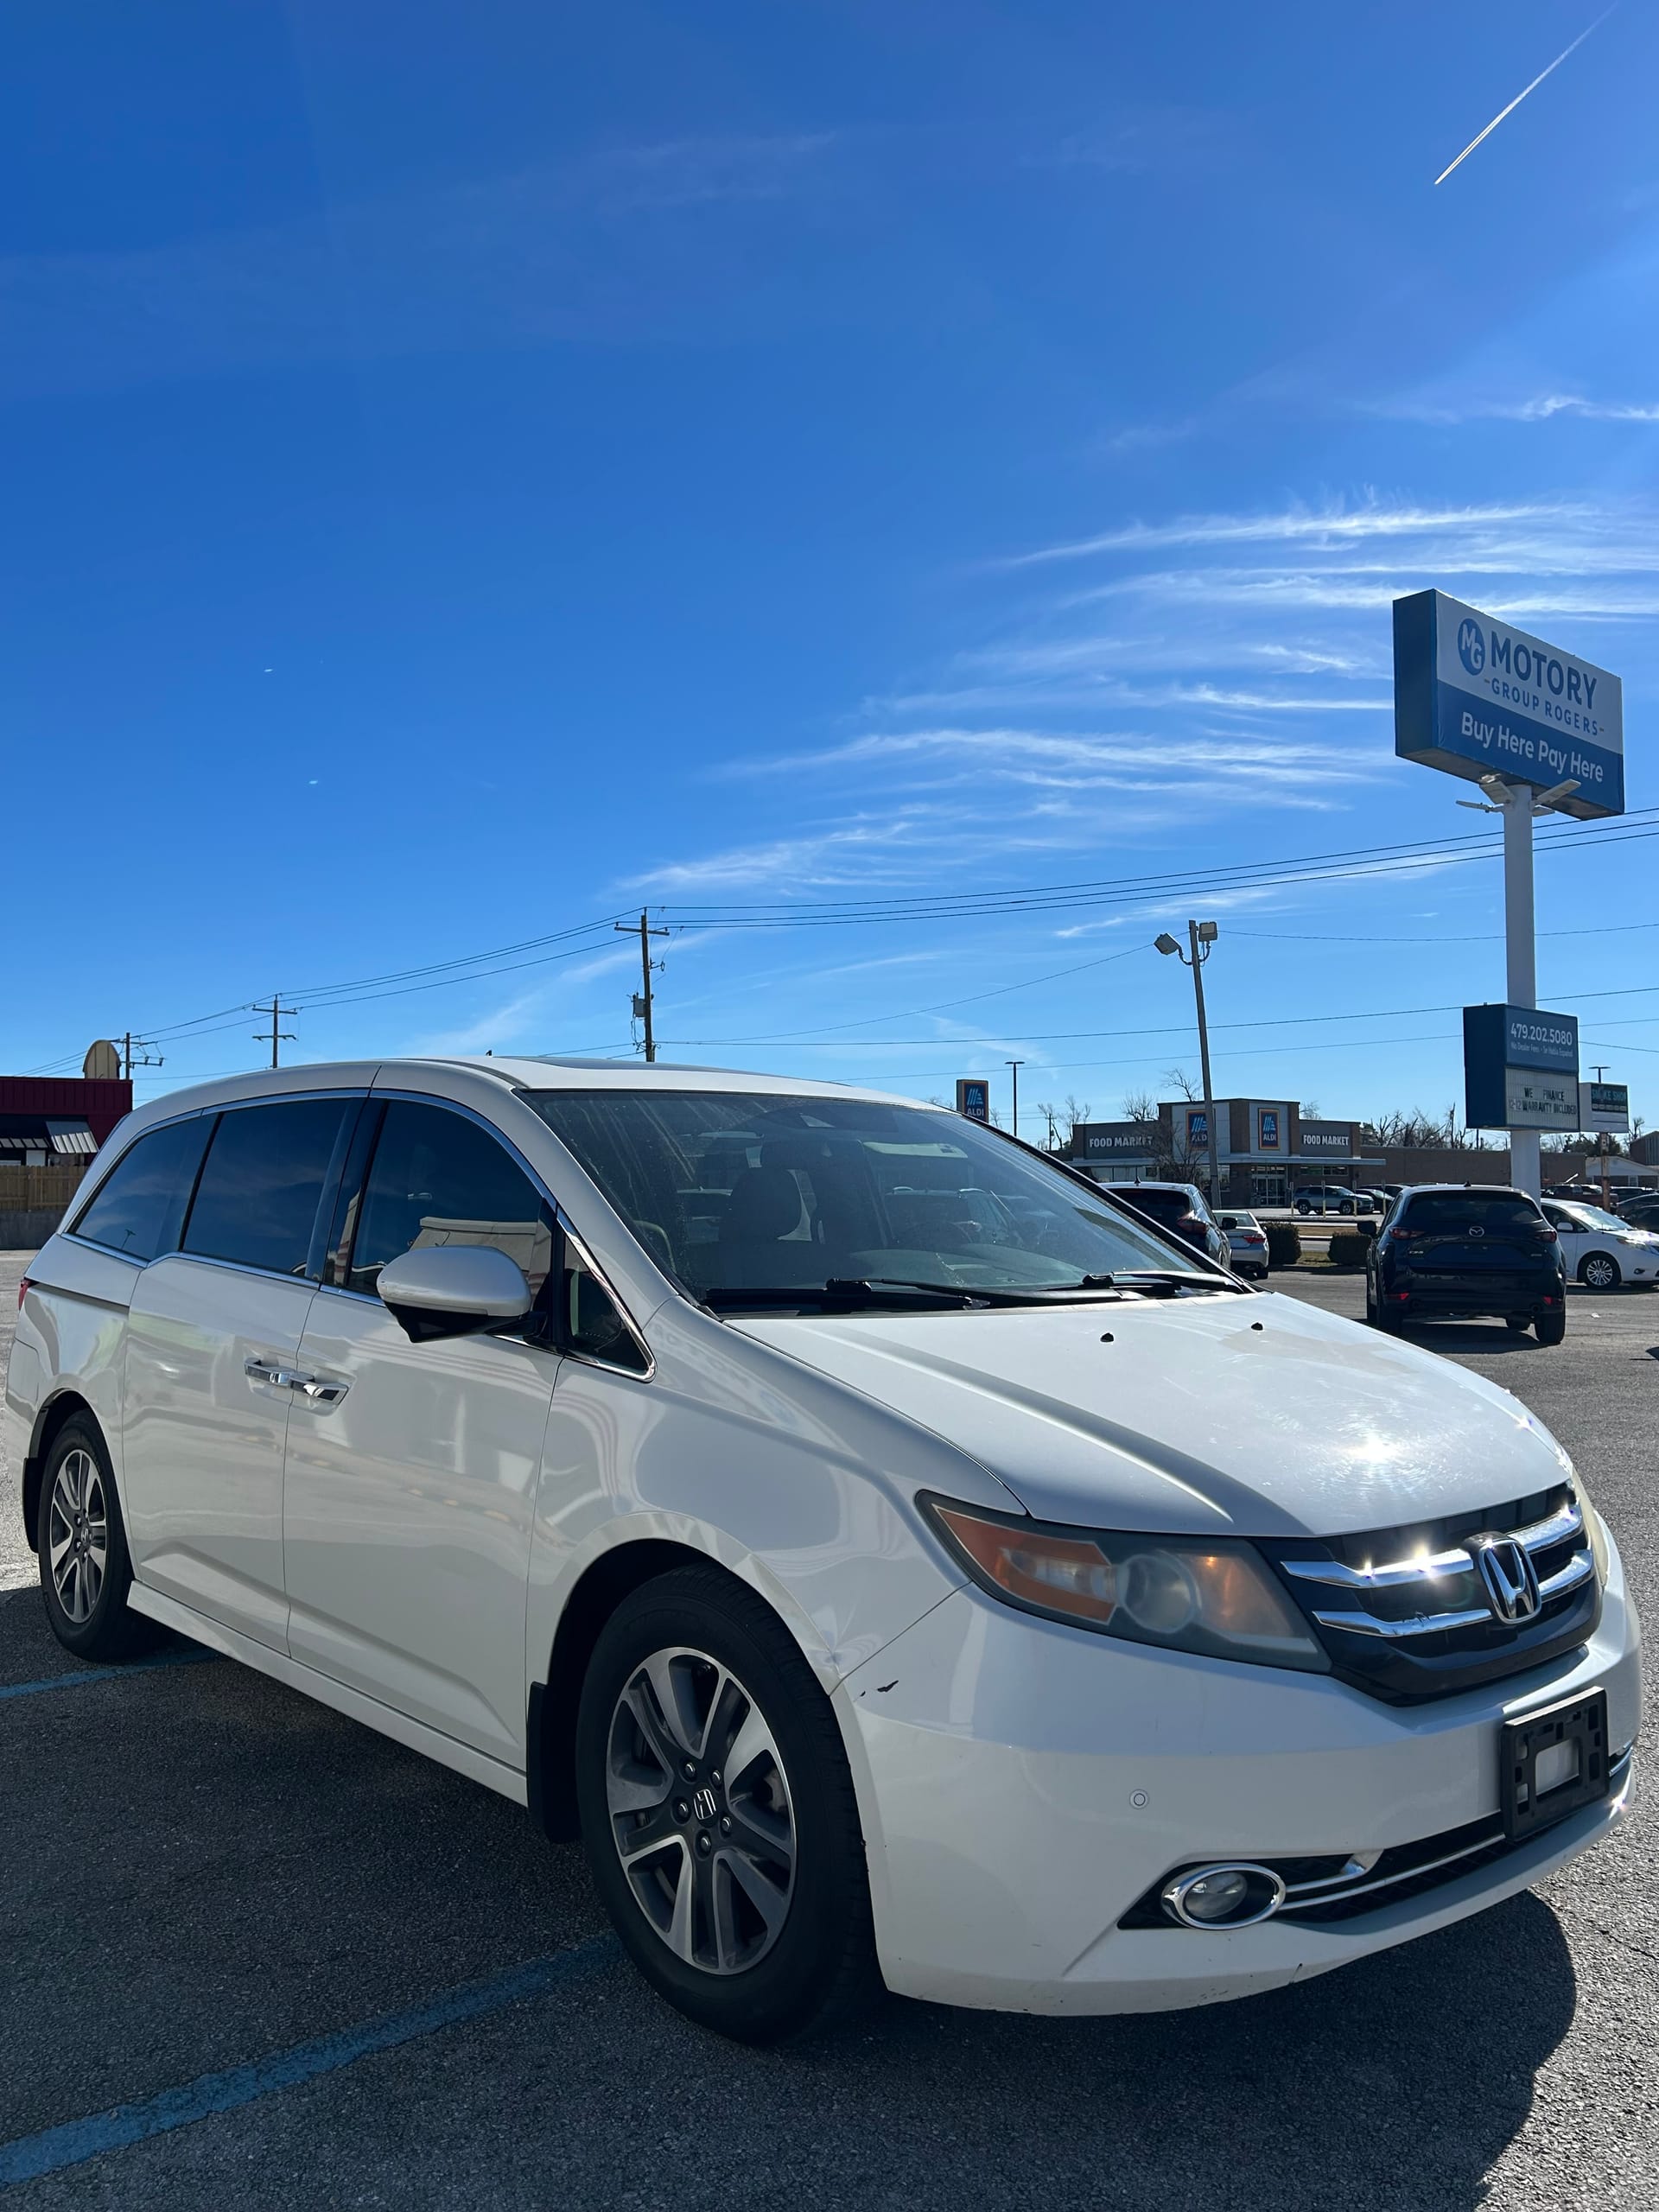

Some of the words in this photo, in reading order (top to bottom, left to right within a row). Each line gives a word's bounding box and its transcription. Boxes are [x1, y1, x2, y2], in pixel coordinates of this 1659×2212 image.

[1491, 630, 1598, 710] MOTORY
[1461, 711, 1495, 749] Buy
[1497, 724, 1535, 759] Here
[1539, 740, 1568, 775] Pay
[1570, 750, 1604, 783] Here
[1510, 1022, 1573, 1046] 479.202.5080
[967, 1108, 984, 1116] ALDI
[1089, 1137, 1112, 1147] FOOD
[1191, 1133, 1208, 1142] ALD
[1263, 1133, 1276, 1141] ALDI
[1303, 1135, 1321, 1145] FOOD
[1322, 1135, 1350, 1146] MARKET
